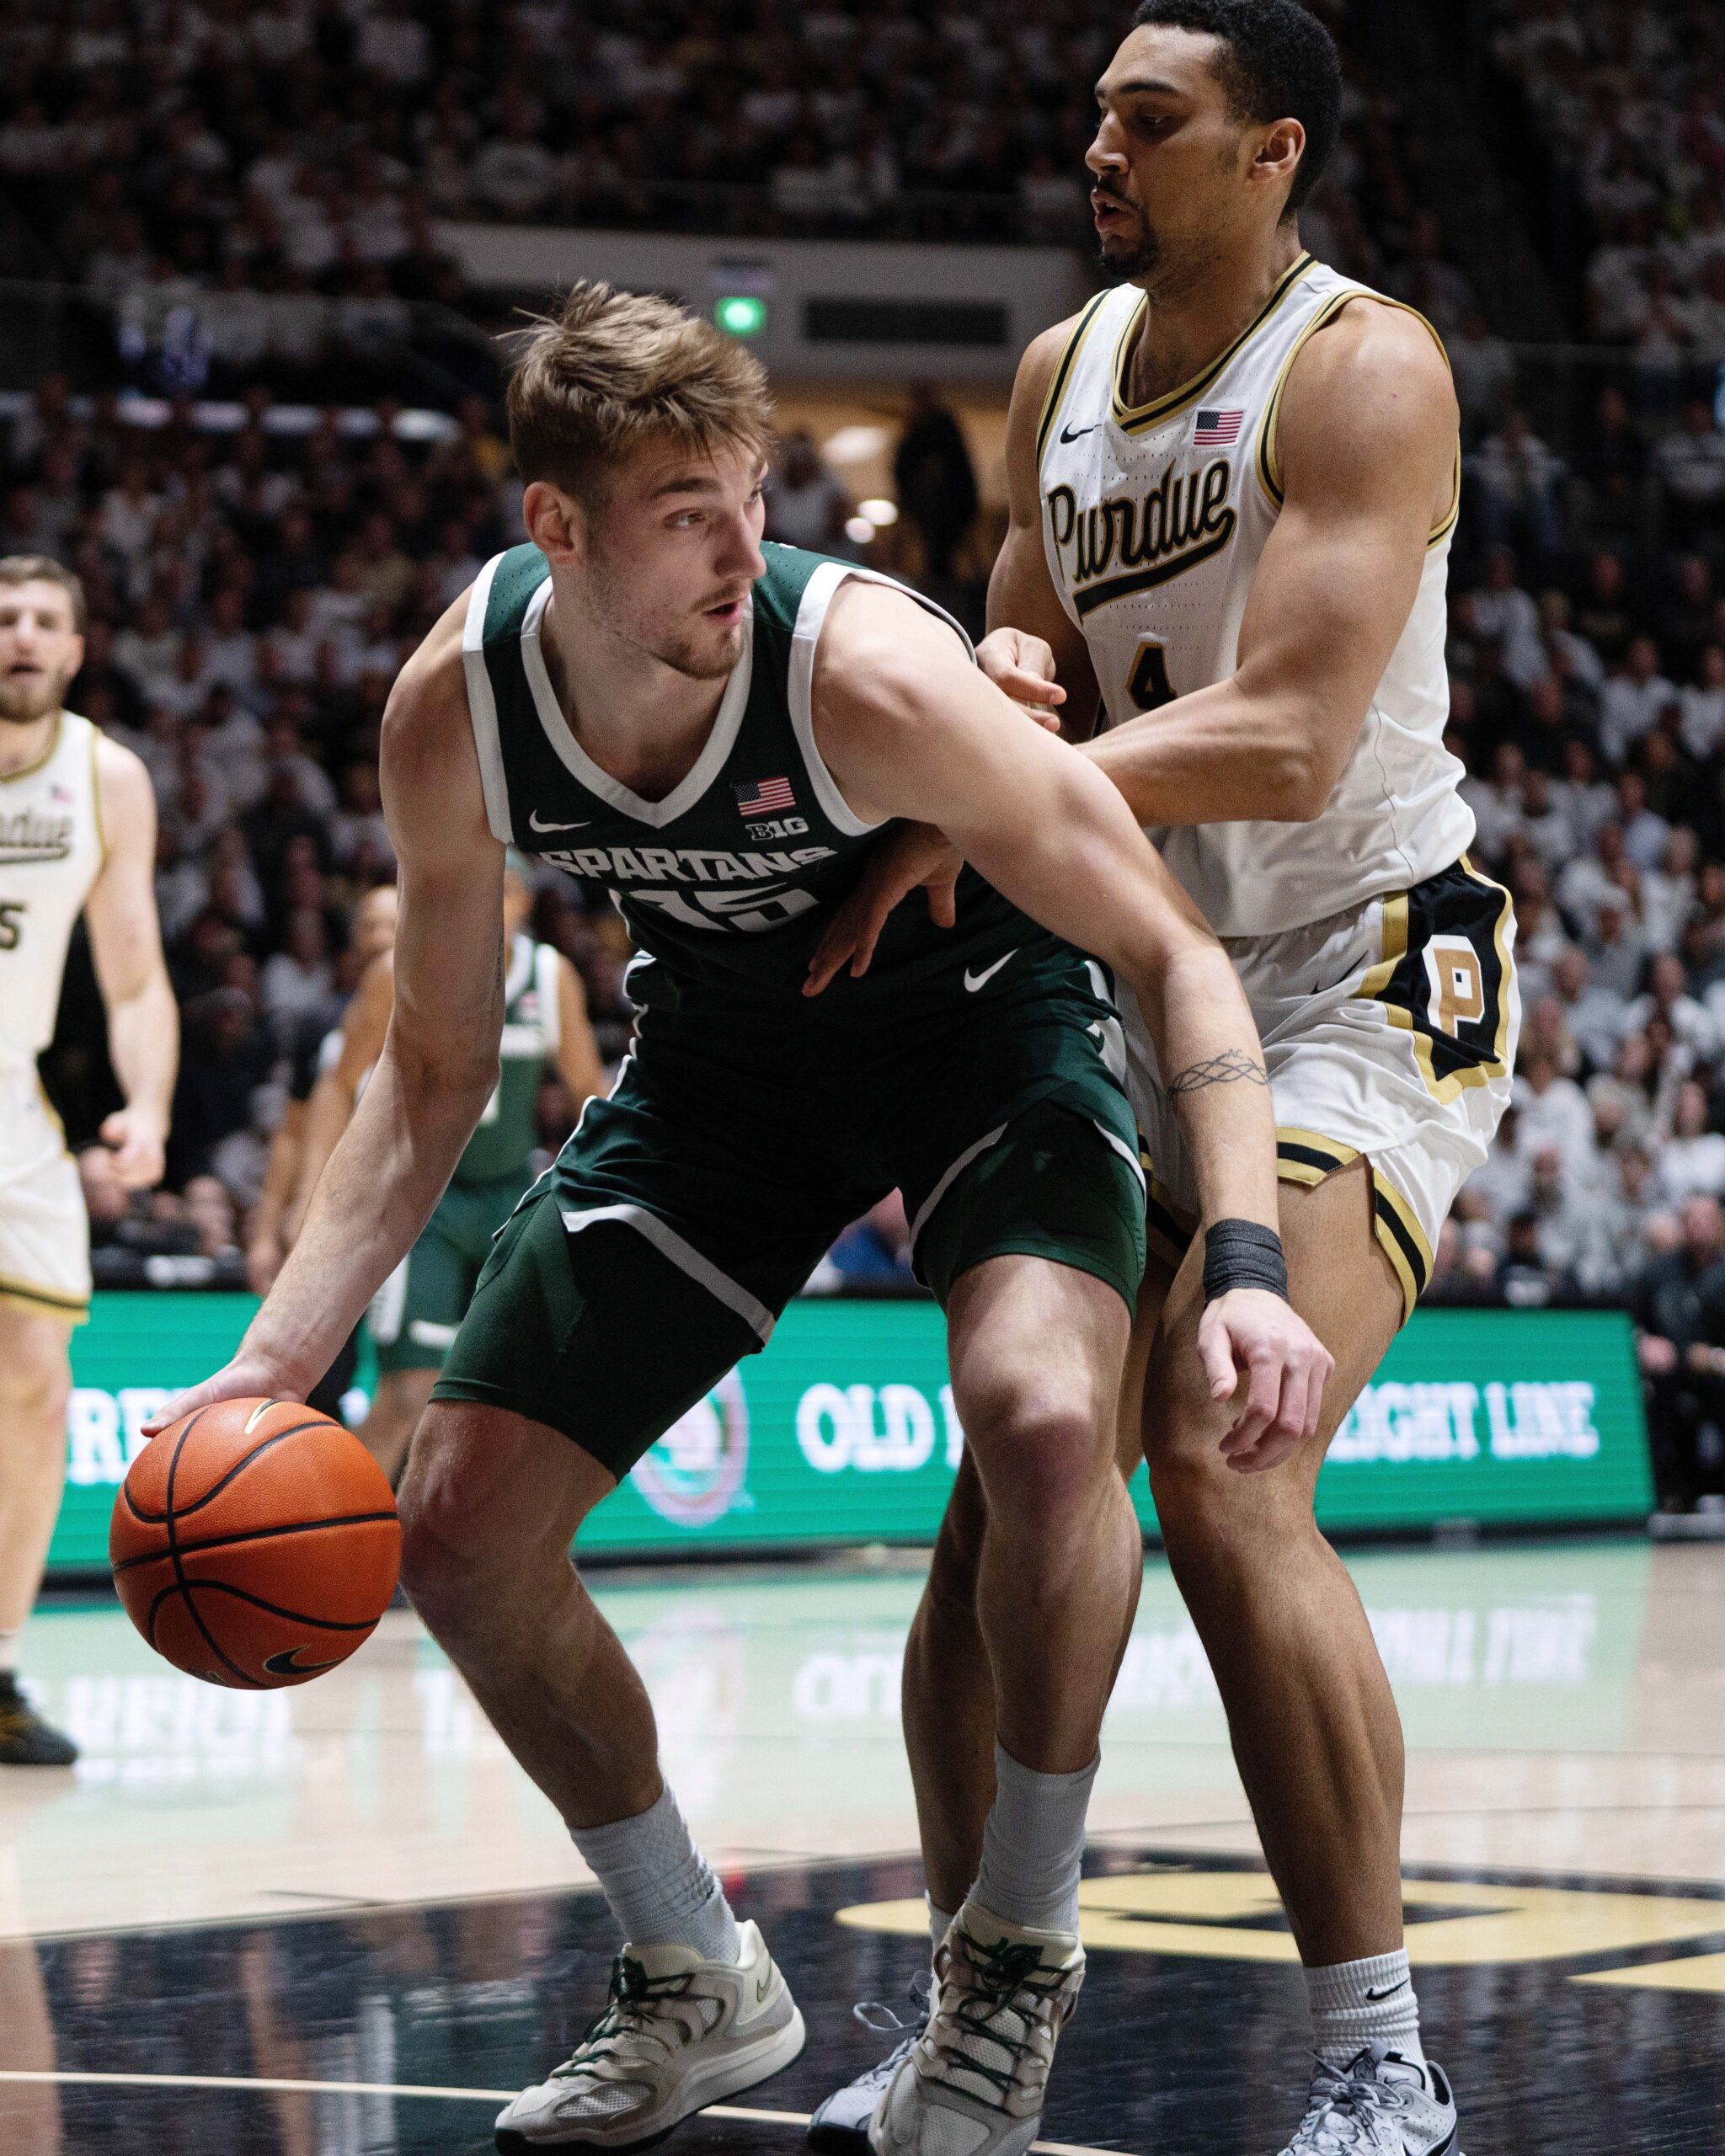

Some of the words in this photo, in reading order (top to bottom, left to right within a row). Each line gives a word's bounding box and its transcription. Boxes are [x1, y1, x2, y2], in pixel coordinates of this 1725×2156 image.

[1045, 459, 1236, 587] Purdue
[1125, 641, 1178, 710] 4
[539, 846, 838, 882] SPARTANS
[1422, 934, 1486, 1040] P
[796, 1382, 936, 1473] OLD
